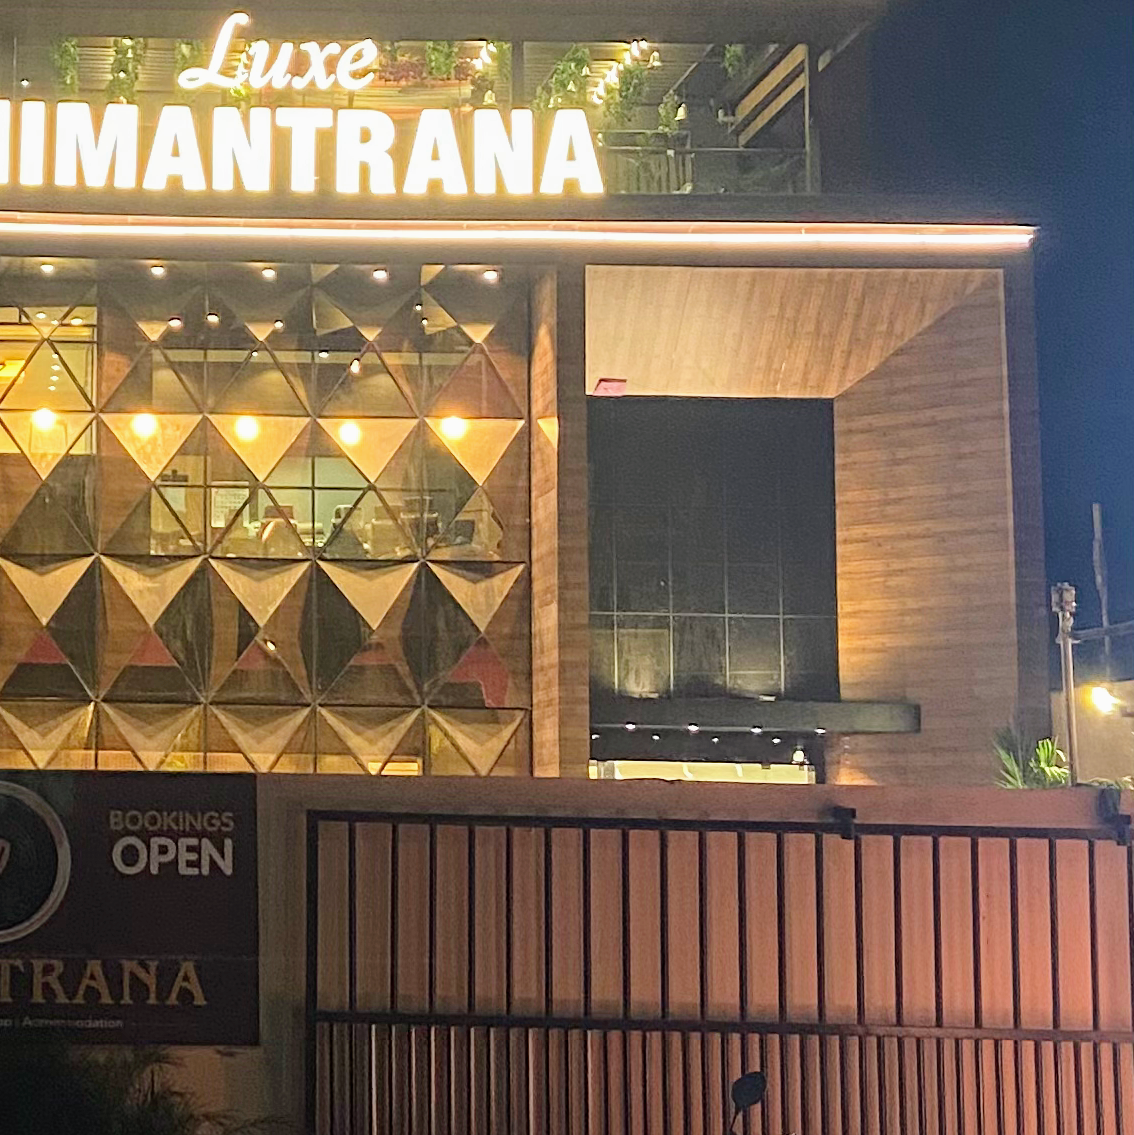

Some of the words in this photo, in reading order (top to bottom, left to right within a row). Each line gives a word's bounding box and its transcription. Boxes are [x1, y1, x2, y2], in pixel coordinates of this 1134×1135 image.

[179, 11, 379, 91] Luxe
[109, 810, 235, 832] BOOKINGS
[112, 837, 234, 876] OPEN
[22, 1015, 125, 1030] Accoodation
